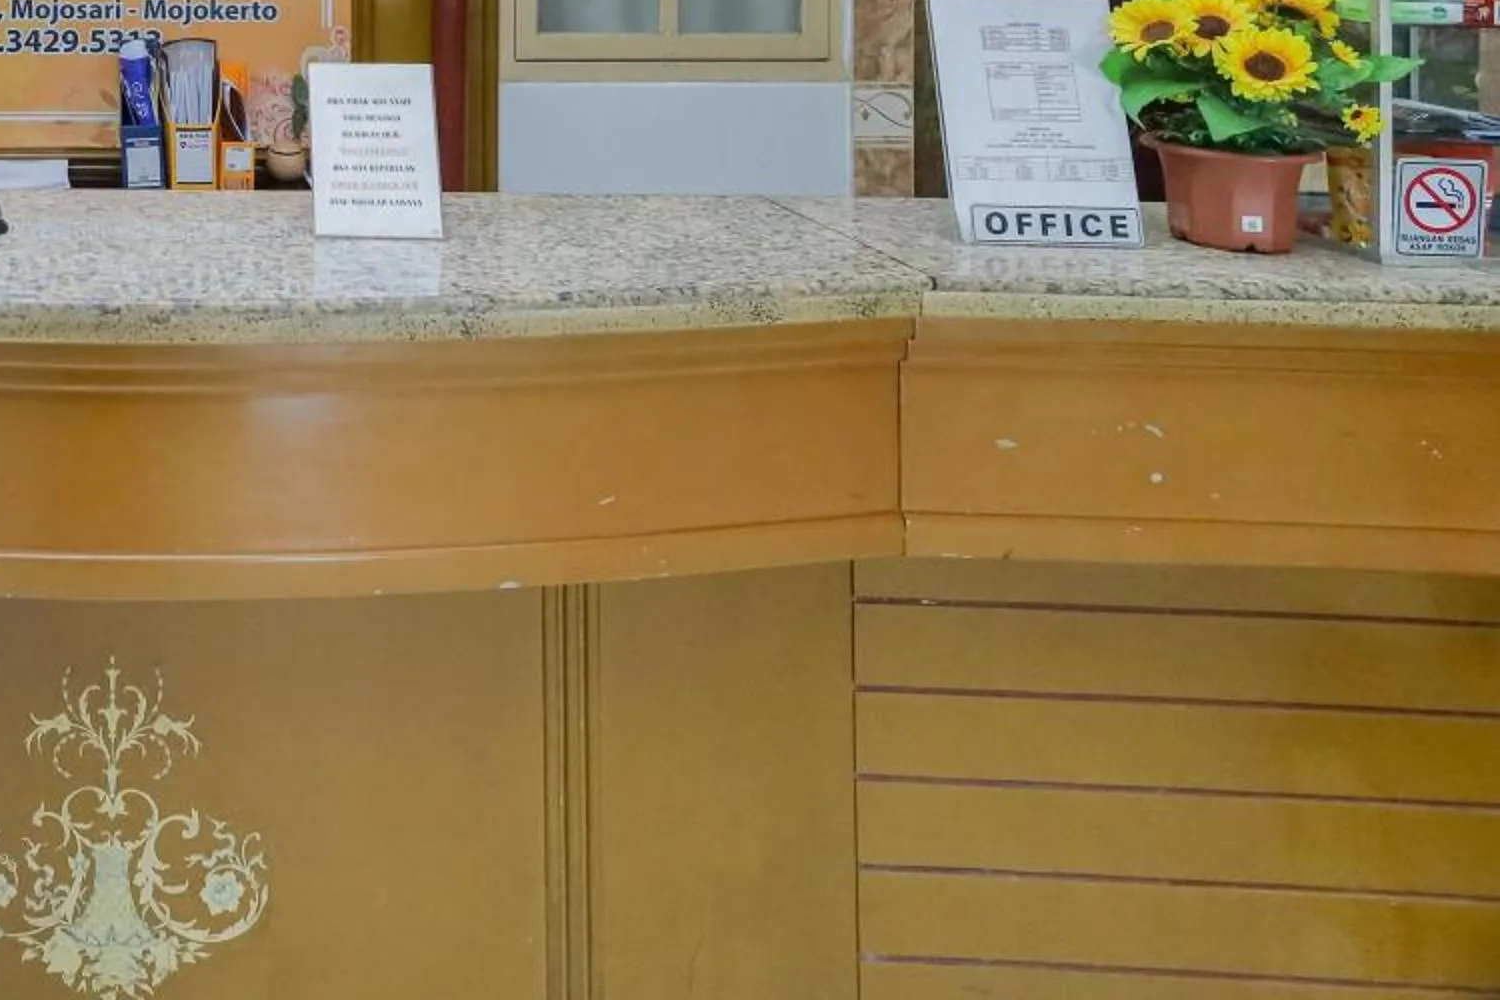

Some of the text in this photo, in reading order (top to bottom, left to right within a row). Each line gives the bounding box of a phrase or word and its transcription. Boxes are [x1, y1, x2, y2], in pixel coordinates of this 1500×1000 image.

[11, 0, 121, 25] Mojosari
[143, 0, 277, 25] Mojokerto
[984, 210, 1131, 239] OFFICE
